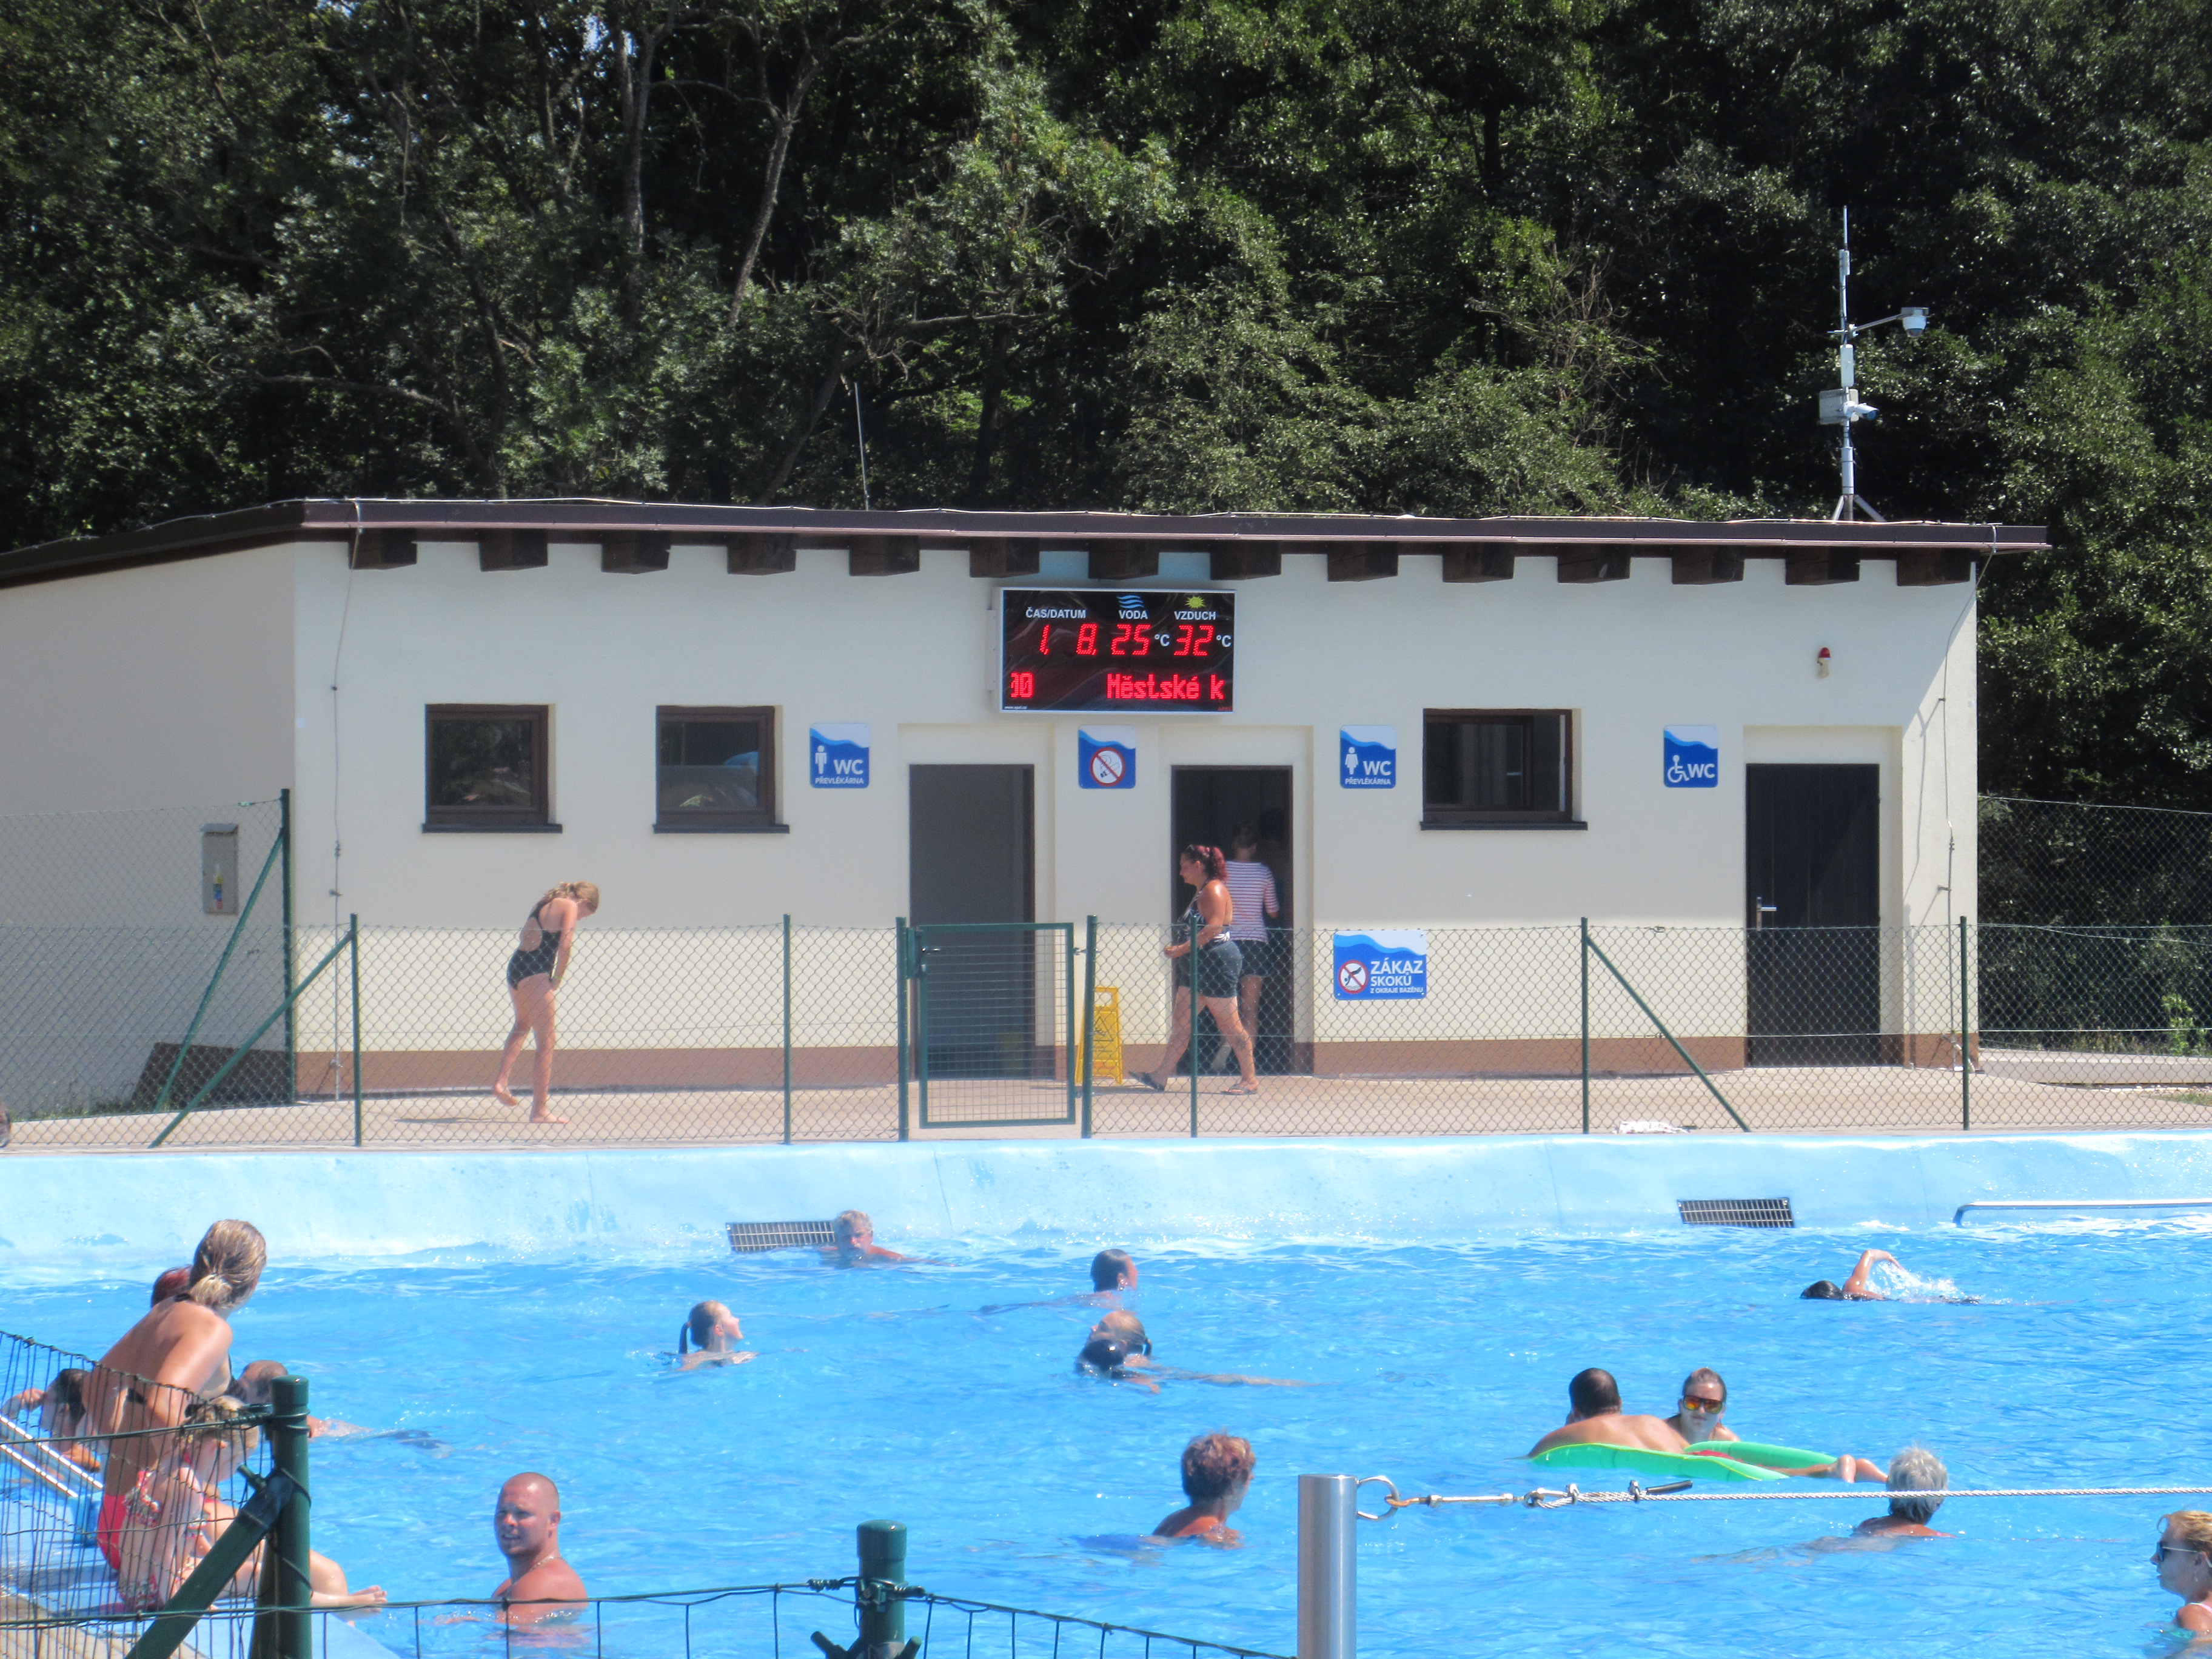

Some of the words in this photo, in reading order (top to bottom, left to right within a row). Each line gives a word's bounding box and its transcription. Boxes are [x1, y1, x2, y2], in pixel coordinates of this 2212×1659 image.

[1025, 607, 1087, 618] ČAS/DATUM
[1119, 610, 1148, 620] VODA
[1174, 611, 1216, 620] VZDUCH
[1111, 623, 1151, 655] 25
[1154, 634, 1170, 647] °C
[1173, 624, 1215, 656] 32
[1216, 634, 1232, 648] °C
[1107, 673, 1200, 700] Městské
[1210, 674, 1225, 700] k
[833, 759, 863, 775] WC
[1362, 760, 1392, 776] WC
[1687, 763, 1715, 779] WC
[1370, 957, 1423, 974] ZÁKAZ
[1370, 972, 1412, 987] SKOKŮ
